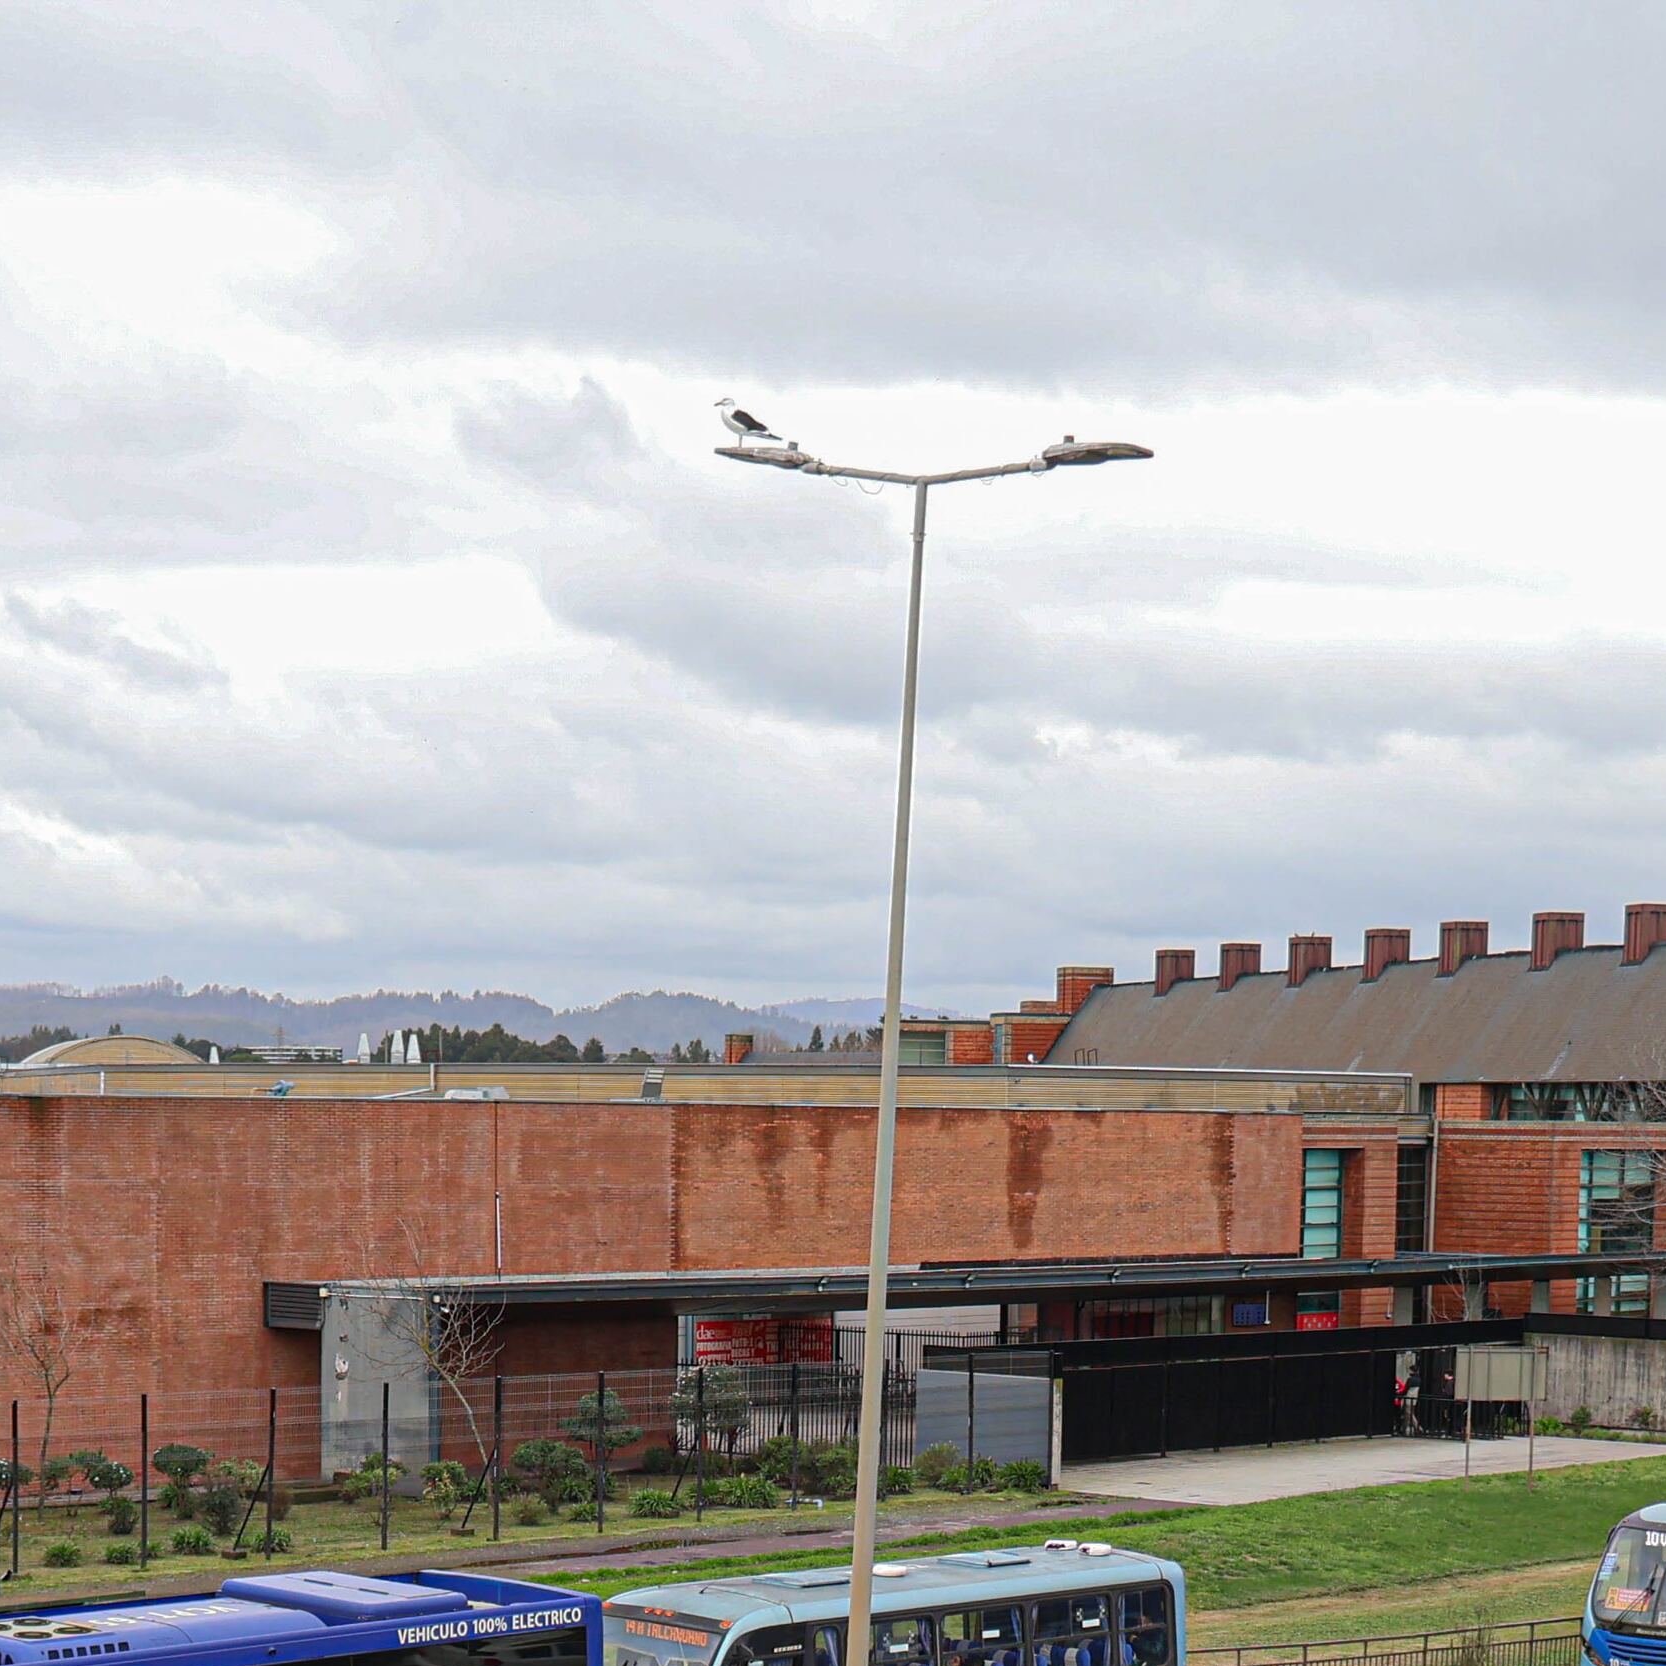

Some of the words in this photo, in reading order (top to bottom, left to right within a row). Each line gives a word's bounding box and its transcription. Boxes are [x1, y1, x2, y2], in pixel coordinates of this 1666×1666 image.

[1645, 1530, 1659, 1546] 10
[397, 1621, 468, 1645] VEHICULO
[472, 1616, 508, 1634] 100%
[511, 1607, 582, 1631] ELECTRICO
